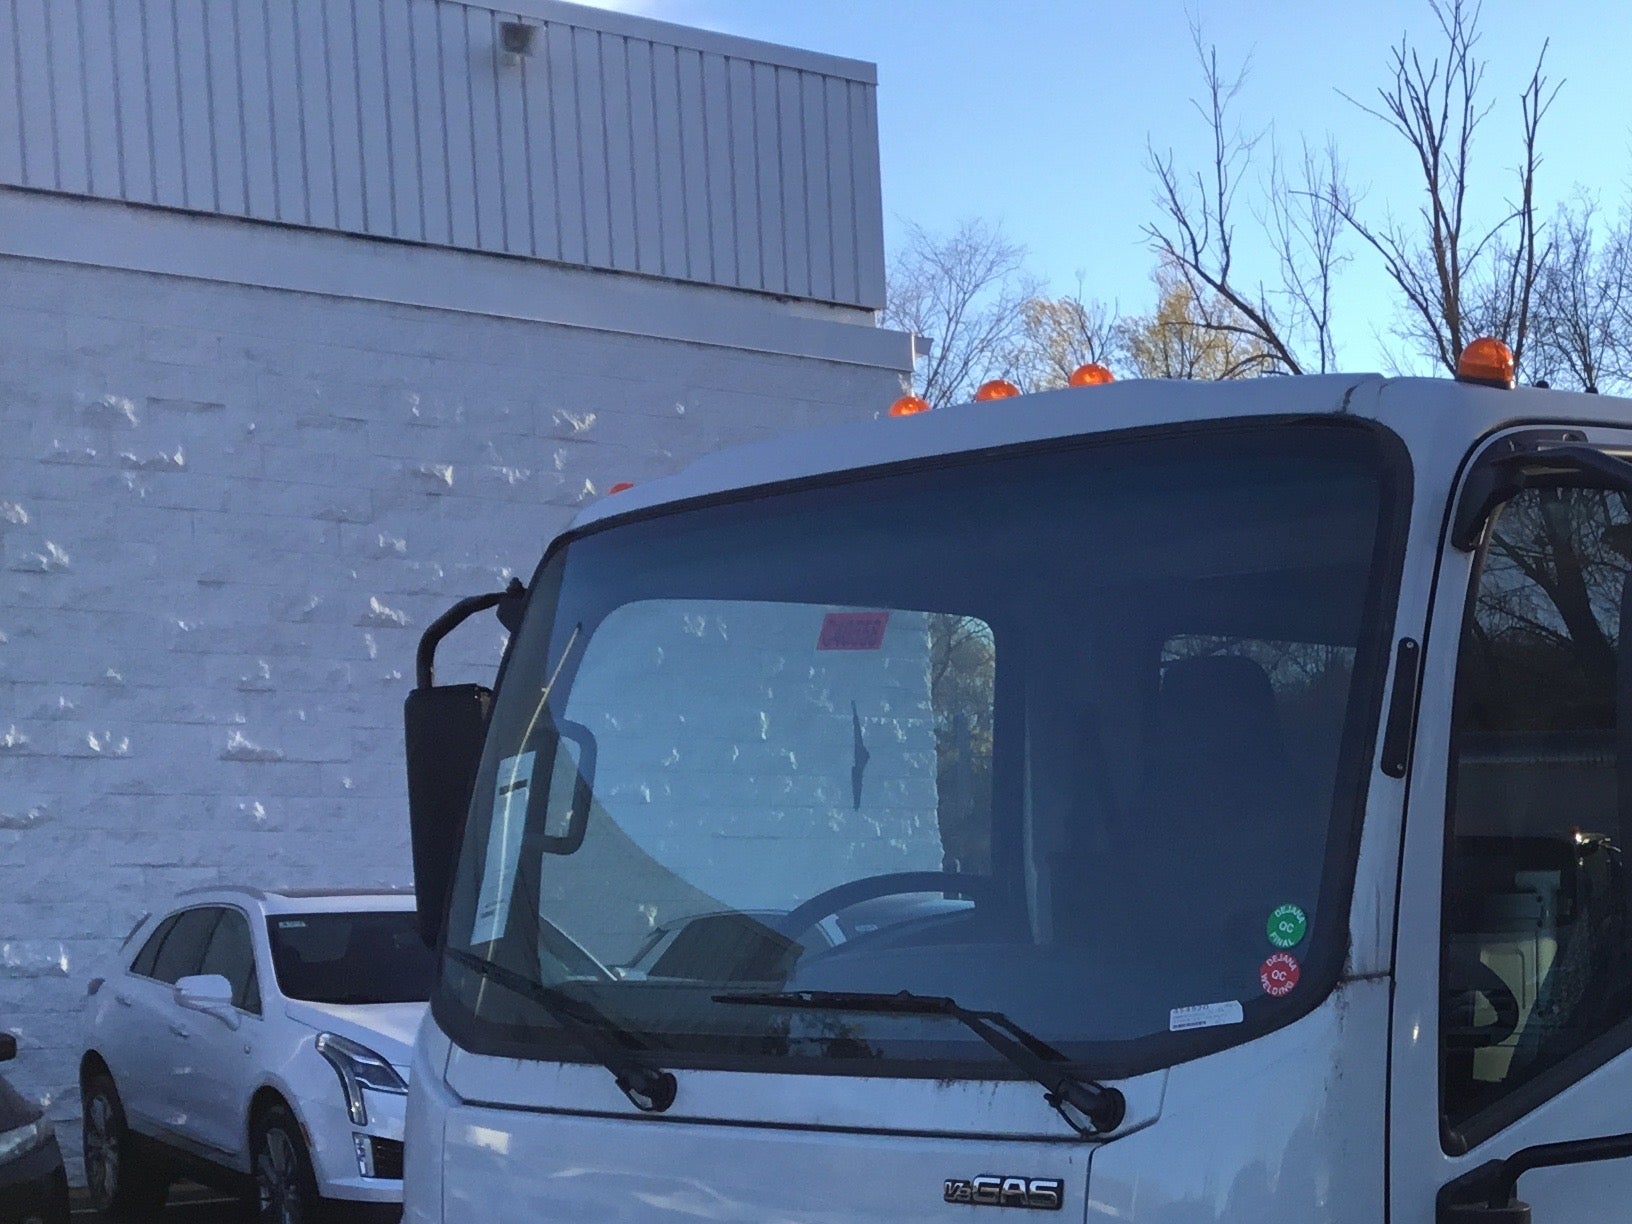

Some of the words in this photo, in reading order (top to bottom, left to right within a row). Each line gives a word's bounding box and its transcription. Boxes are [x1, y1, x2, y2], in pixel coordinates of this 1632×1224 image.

[1274, 904, 1306, 924] DEJANA
[1278, 921, 1295, 933] QC
[1269, 931, 1294, 947] FINAL
[1266, 953, 1297, 972] DEJANA
[1260, 973, 1295, 996] WELDING
[1271, 969, 1287, 981] QC
[972, 1176, 1059, 1207] GAS
